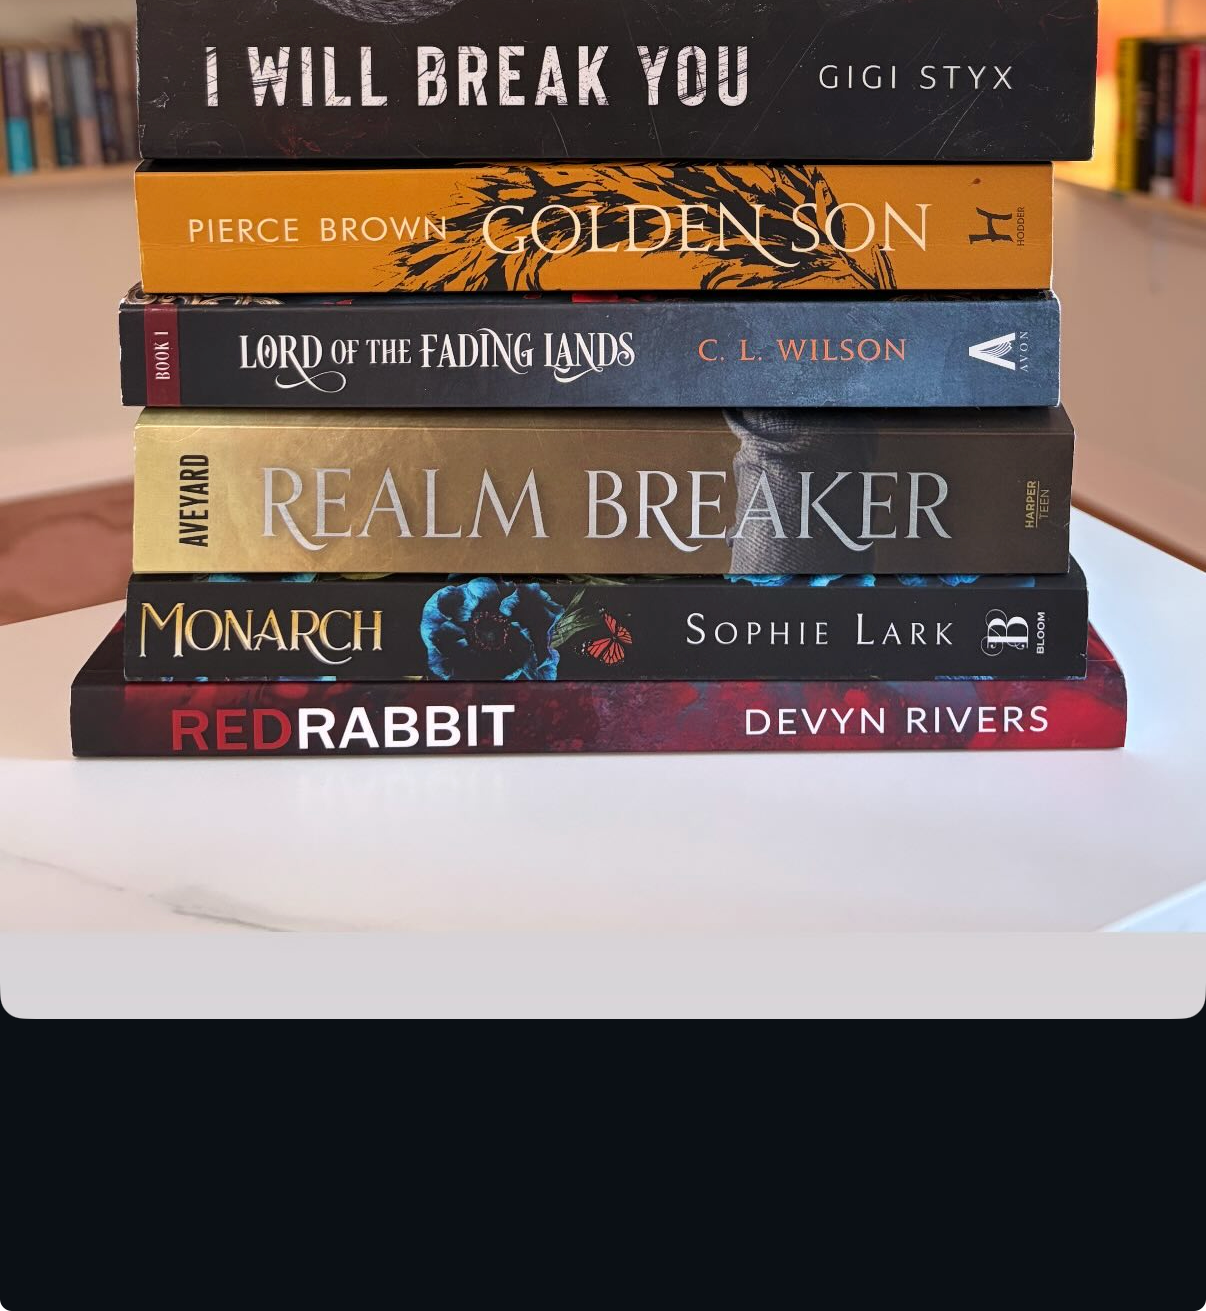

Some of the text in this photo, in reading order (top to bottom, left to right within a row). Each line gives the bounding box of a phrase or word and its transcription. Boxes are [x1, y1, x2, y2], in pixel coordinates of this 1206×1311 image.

[204, 44, 748, 107] I WILL BREAK YOU
[818, 64, 1013, 90] GIGI STYX
[188, 215, 448, 244] PIERCE BROWN
[481, 202, 933, 268] GOLDEN SON
[1016, 206, 1025, 246] HODDER
[154, 341, 171, 380] BOOK
[238, 327, 637, 394] LORD OF THE FADING LANDS
[698, 337, 908, 362] C. L. WILSON
[1019, 330, 1029, 373] AVON
[179, 452, 210, 548] AVEYARD
[261, 466, 953, 553] REALM BREAKER
[1025, 480, 1037, 528] HARPER
[1039, 489, 1050, 520] TEEN
[138, 601, 384, 666] MONARCH
[686, 611, 954, 645] SOPHIE LARK
[1036, 611, 1046, 654] BLOOM
[744, 705, 1050, 736] DEVYN RIVERS
